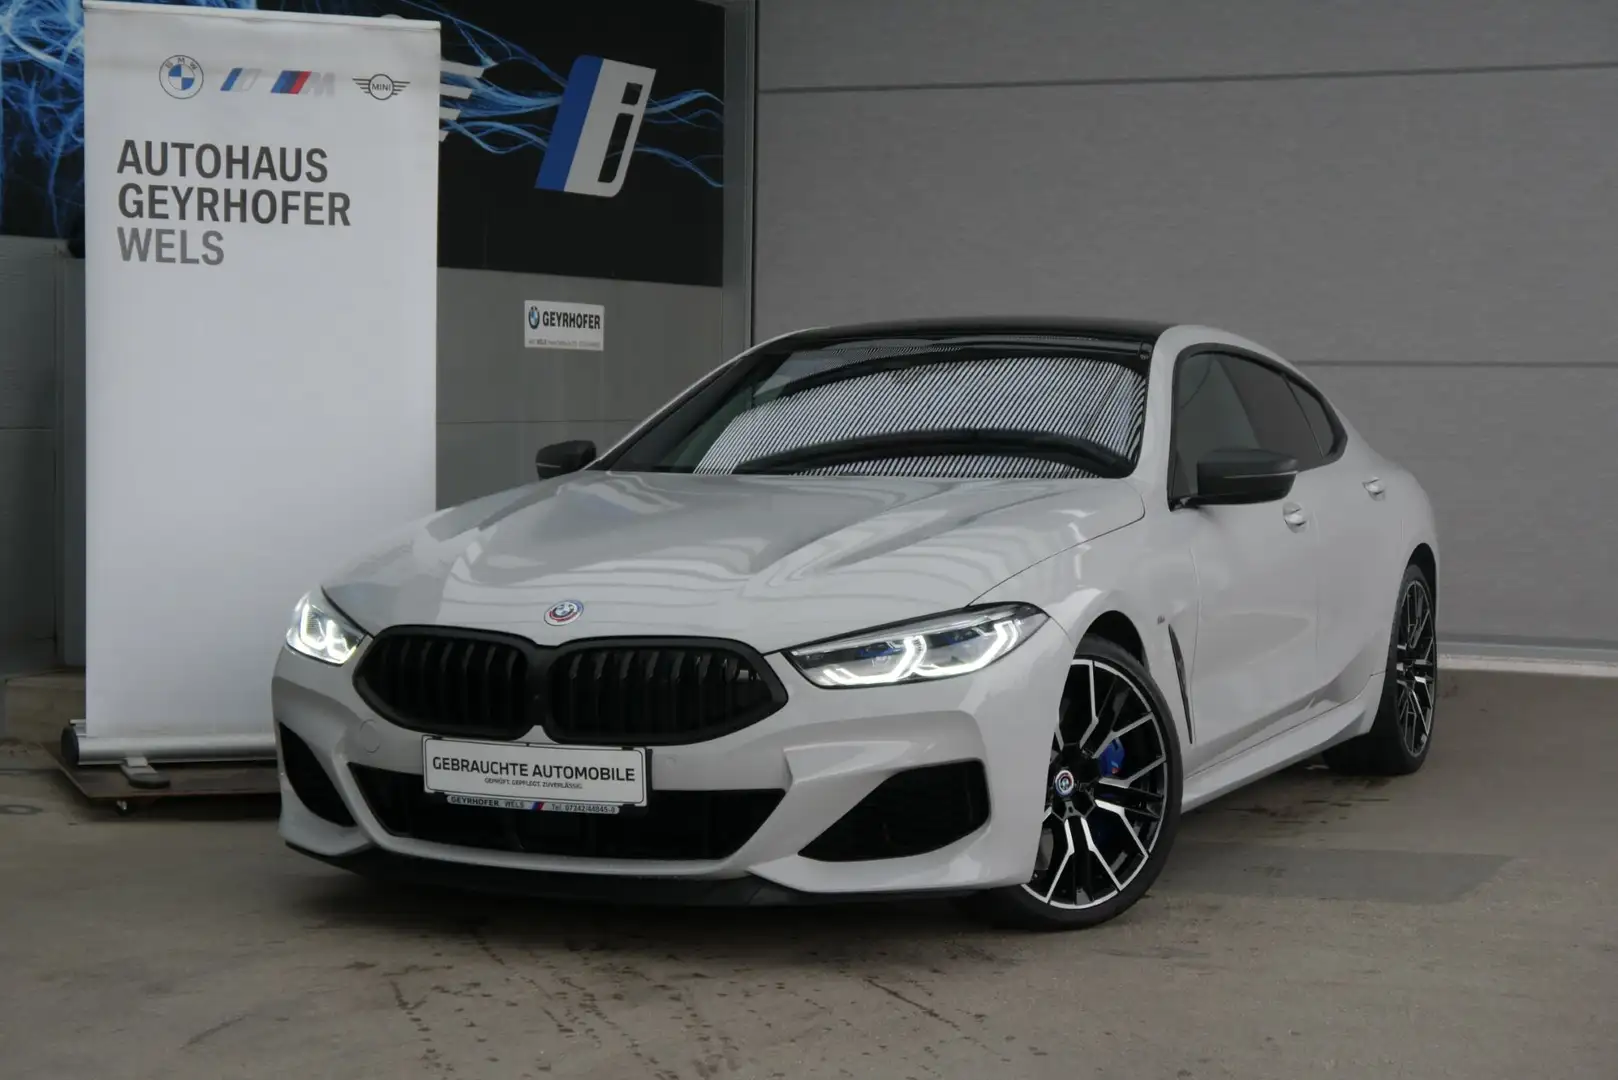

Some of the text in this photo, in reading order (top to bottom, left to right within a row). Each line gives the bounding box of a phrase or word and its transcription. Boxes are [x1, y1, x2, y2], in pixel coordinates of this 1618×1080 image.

[371, 83, 392, 91] MINI
[117, 139, 328, 183] AUTOHAUS
[118, 182, 351, 226] GEYRHOFER
[117, 226, 224, 265] WELS
[542, 311, 601, 330] GEYRHOFER
[432, 756, 636, 781] GEBRAUCHTE AUTOMOBILE
[451, 796, 500, 807] GEYRHOFER
[505, 800, 524, 808] WELS
